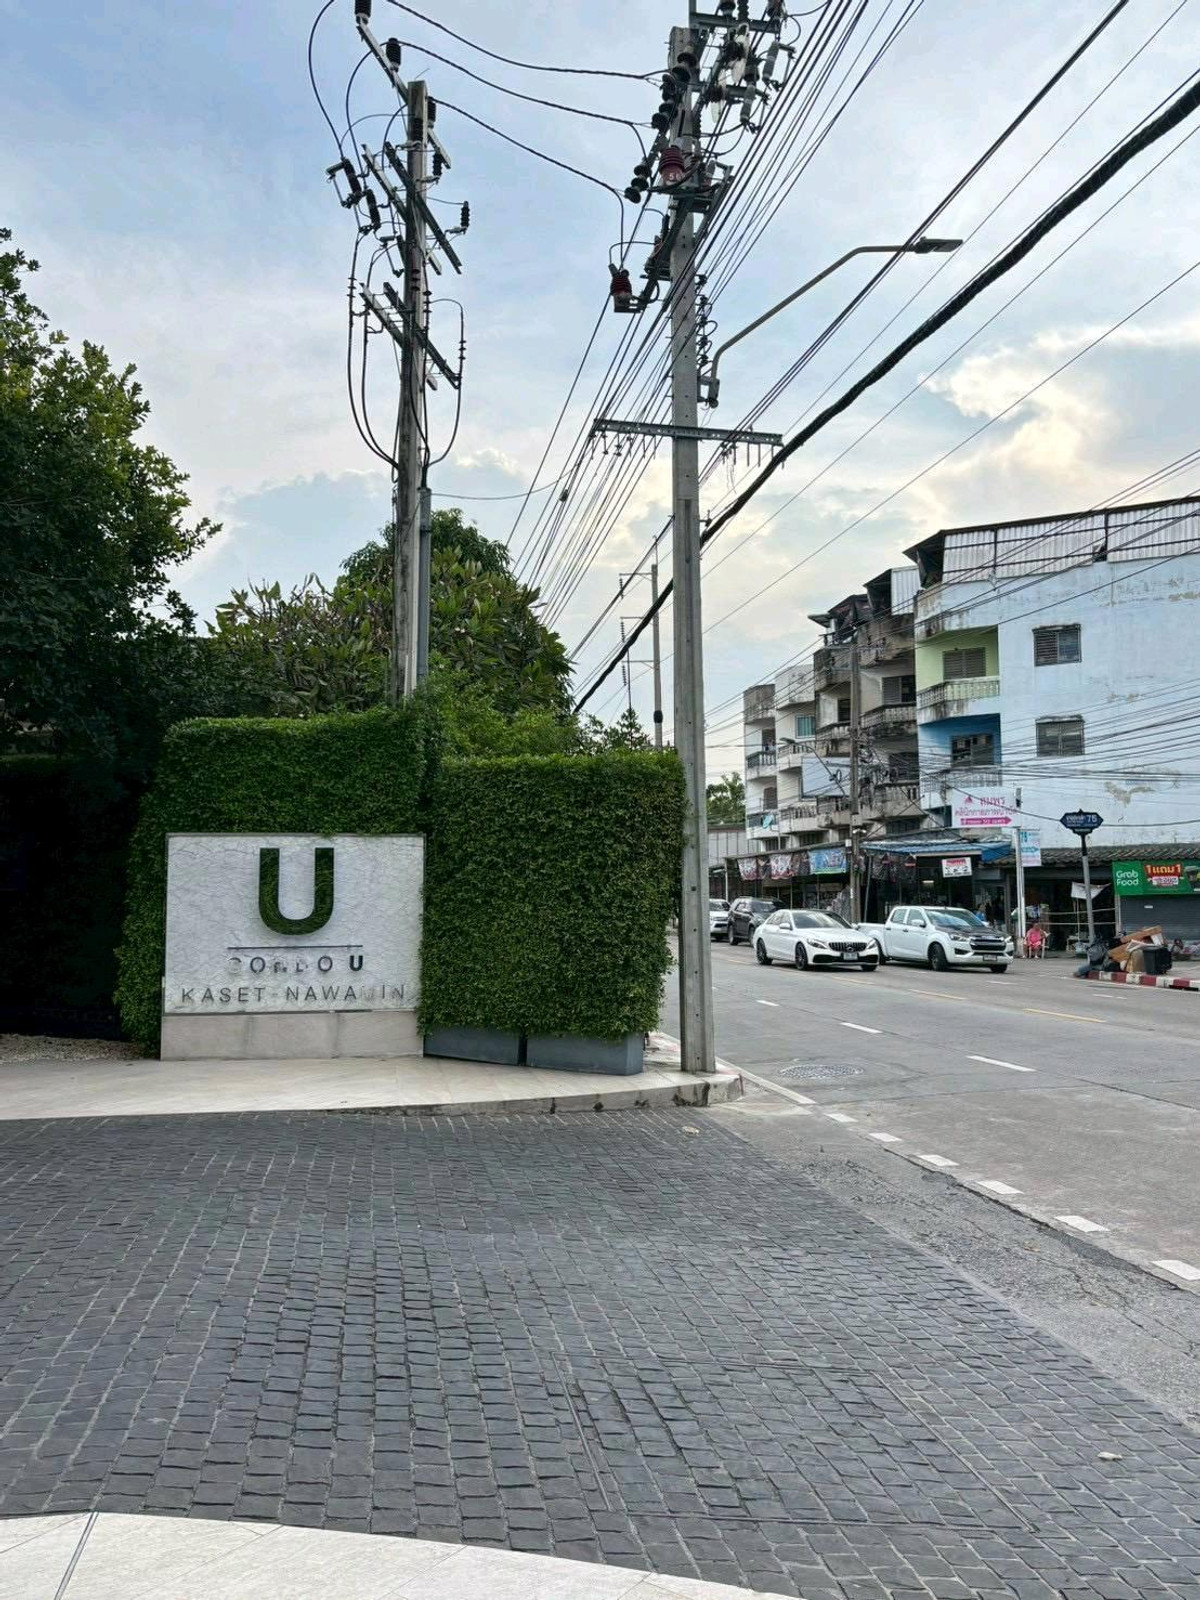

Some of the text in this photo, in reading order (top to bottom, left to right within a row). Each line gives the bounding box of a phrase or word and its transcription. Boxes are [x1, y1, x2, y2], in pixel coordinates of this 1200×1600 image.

[1115, 869, 1139, 879] Grab
[1116, 878, 1139, 887] Food
[258, 847, 335, 936] U
[349, 954, 364, 972] U
